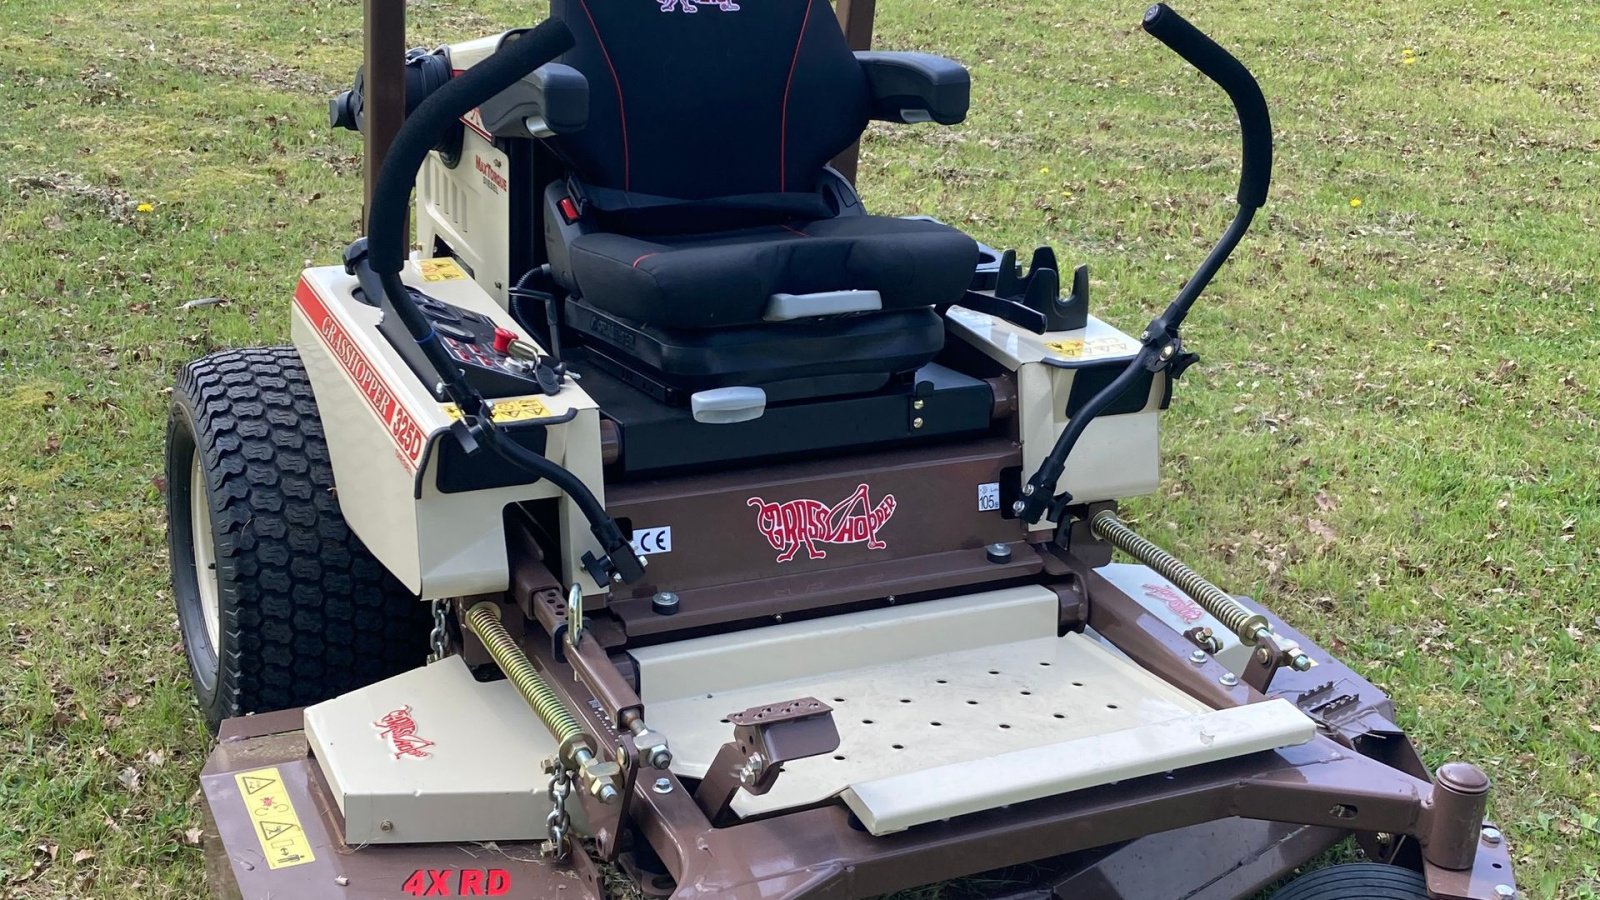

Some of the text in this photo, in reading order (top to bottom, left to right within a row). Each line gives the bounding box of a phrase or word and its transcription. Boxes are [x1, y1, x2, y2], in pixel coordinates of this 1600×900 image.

[321, 316, 422, 461] GRASSHOPPER 325D
[747, 484, 896, 563] GRASSHOPPER
[979, 494, 995, 510] 105
[640, 530, 666, 552] CE
